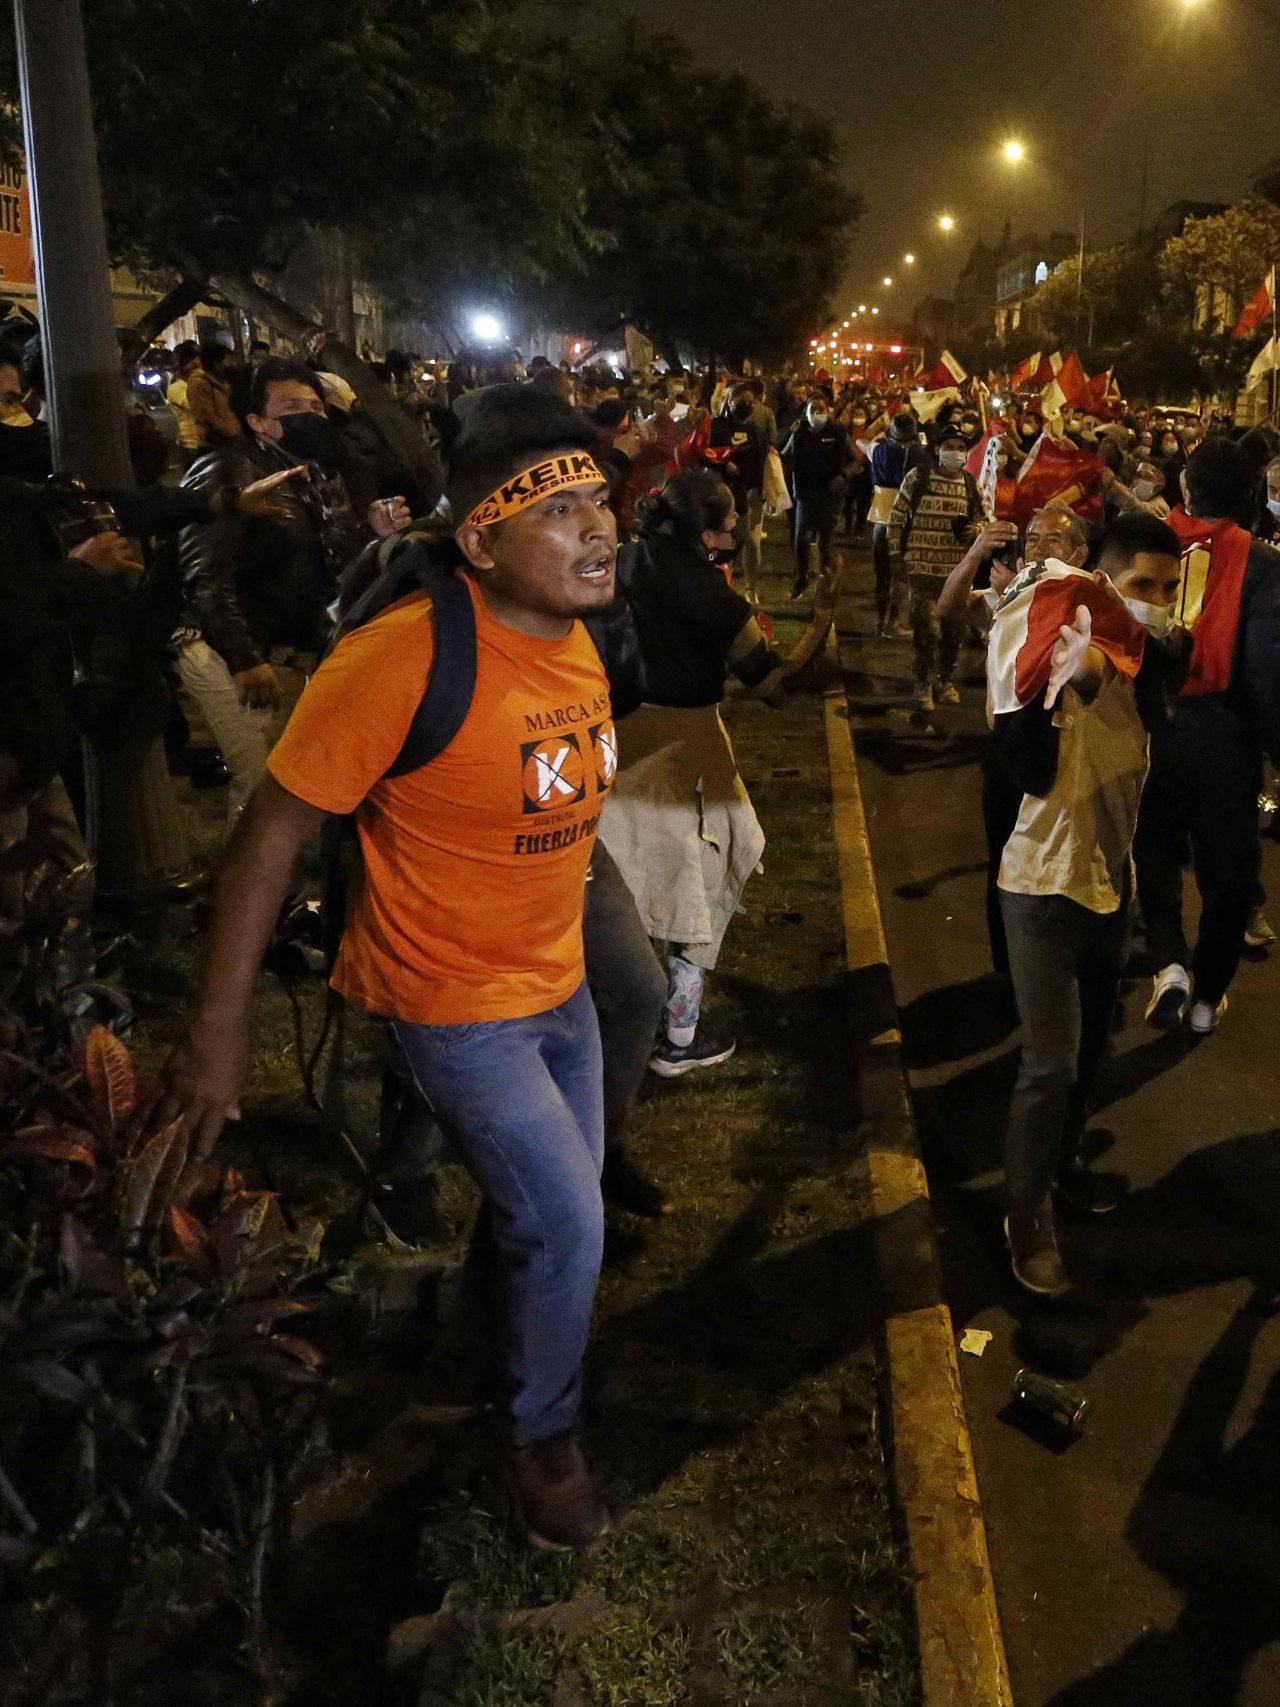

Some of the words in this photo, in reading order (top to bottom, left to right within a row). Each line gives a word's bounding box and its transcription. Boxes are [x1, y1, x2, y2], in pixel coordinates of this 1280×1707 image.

[524, 703, 591, 732] MARCA
[533, 746, 576, 801] K
[514, 823, 579, 855] FUERZA
